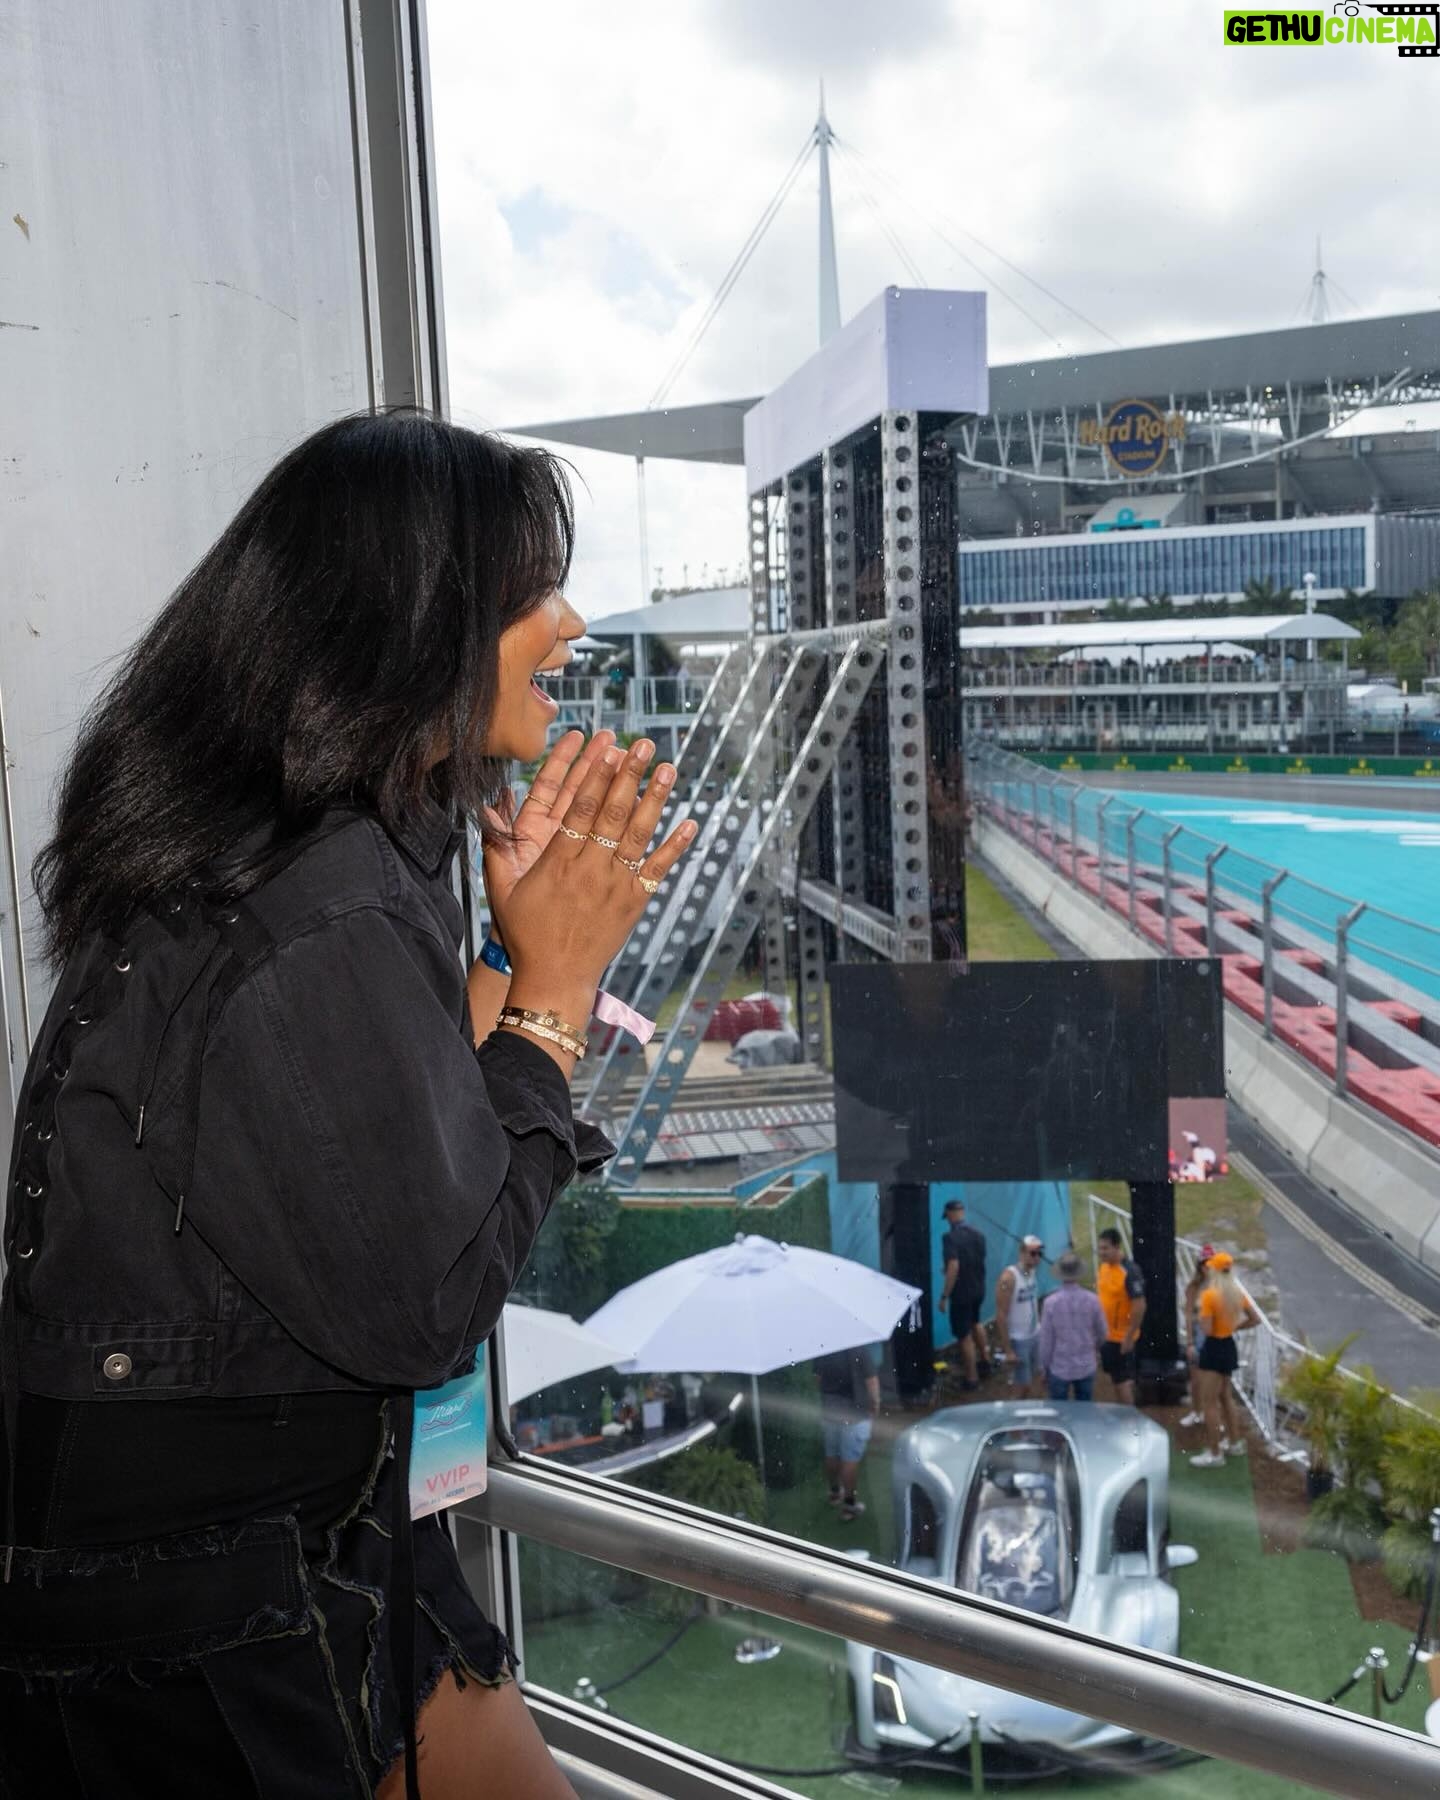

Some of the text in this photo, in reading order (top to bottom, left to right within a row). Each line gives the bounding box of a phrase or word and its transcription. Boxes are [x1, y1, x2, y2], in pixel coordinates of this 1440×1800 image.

[1079, 412, 1185, 446] Hard Rock
[426, 1464, 470, 1493] VVIP
